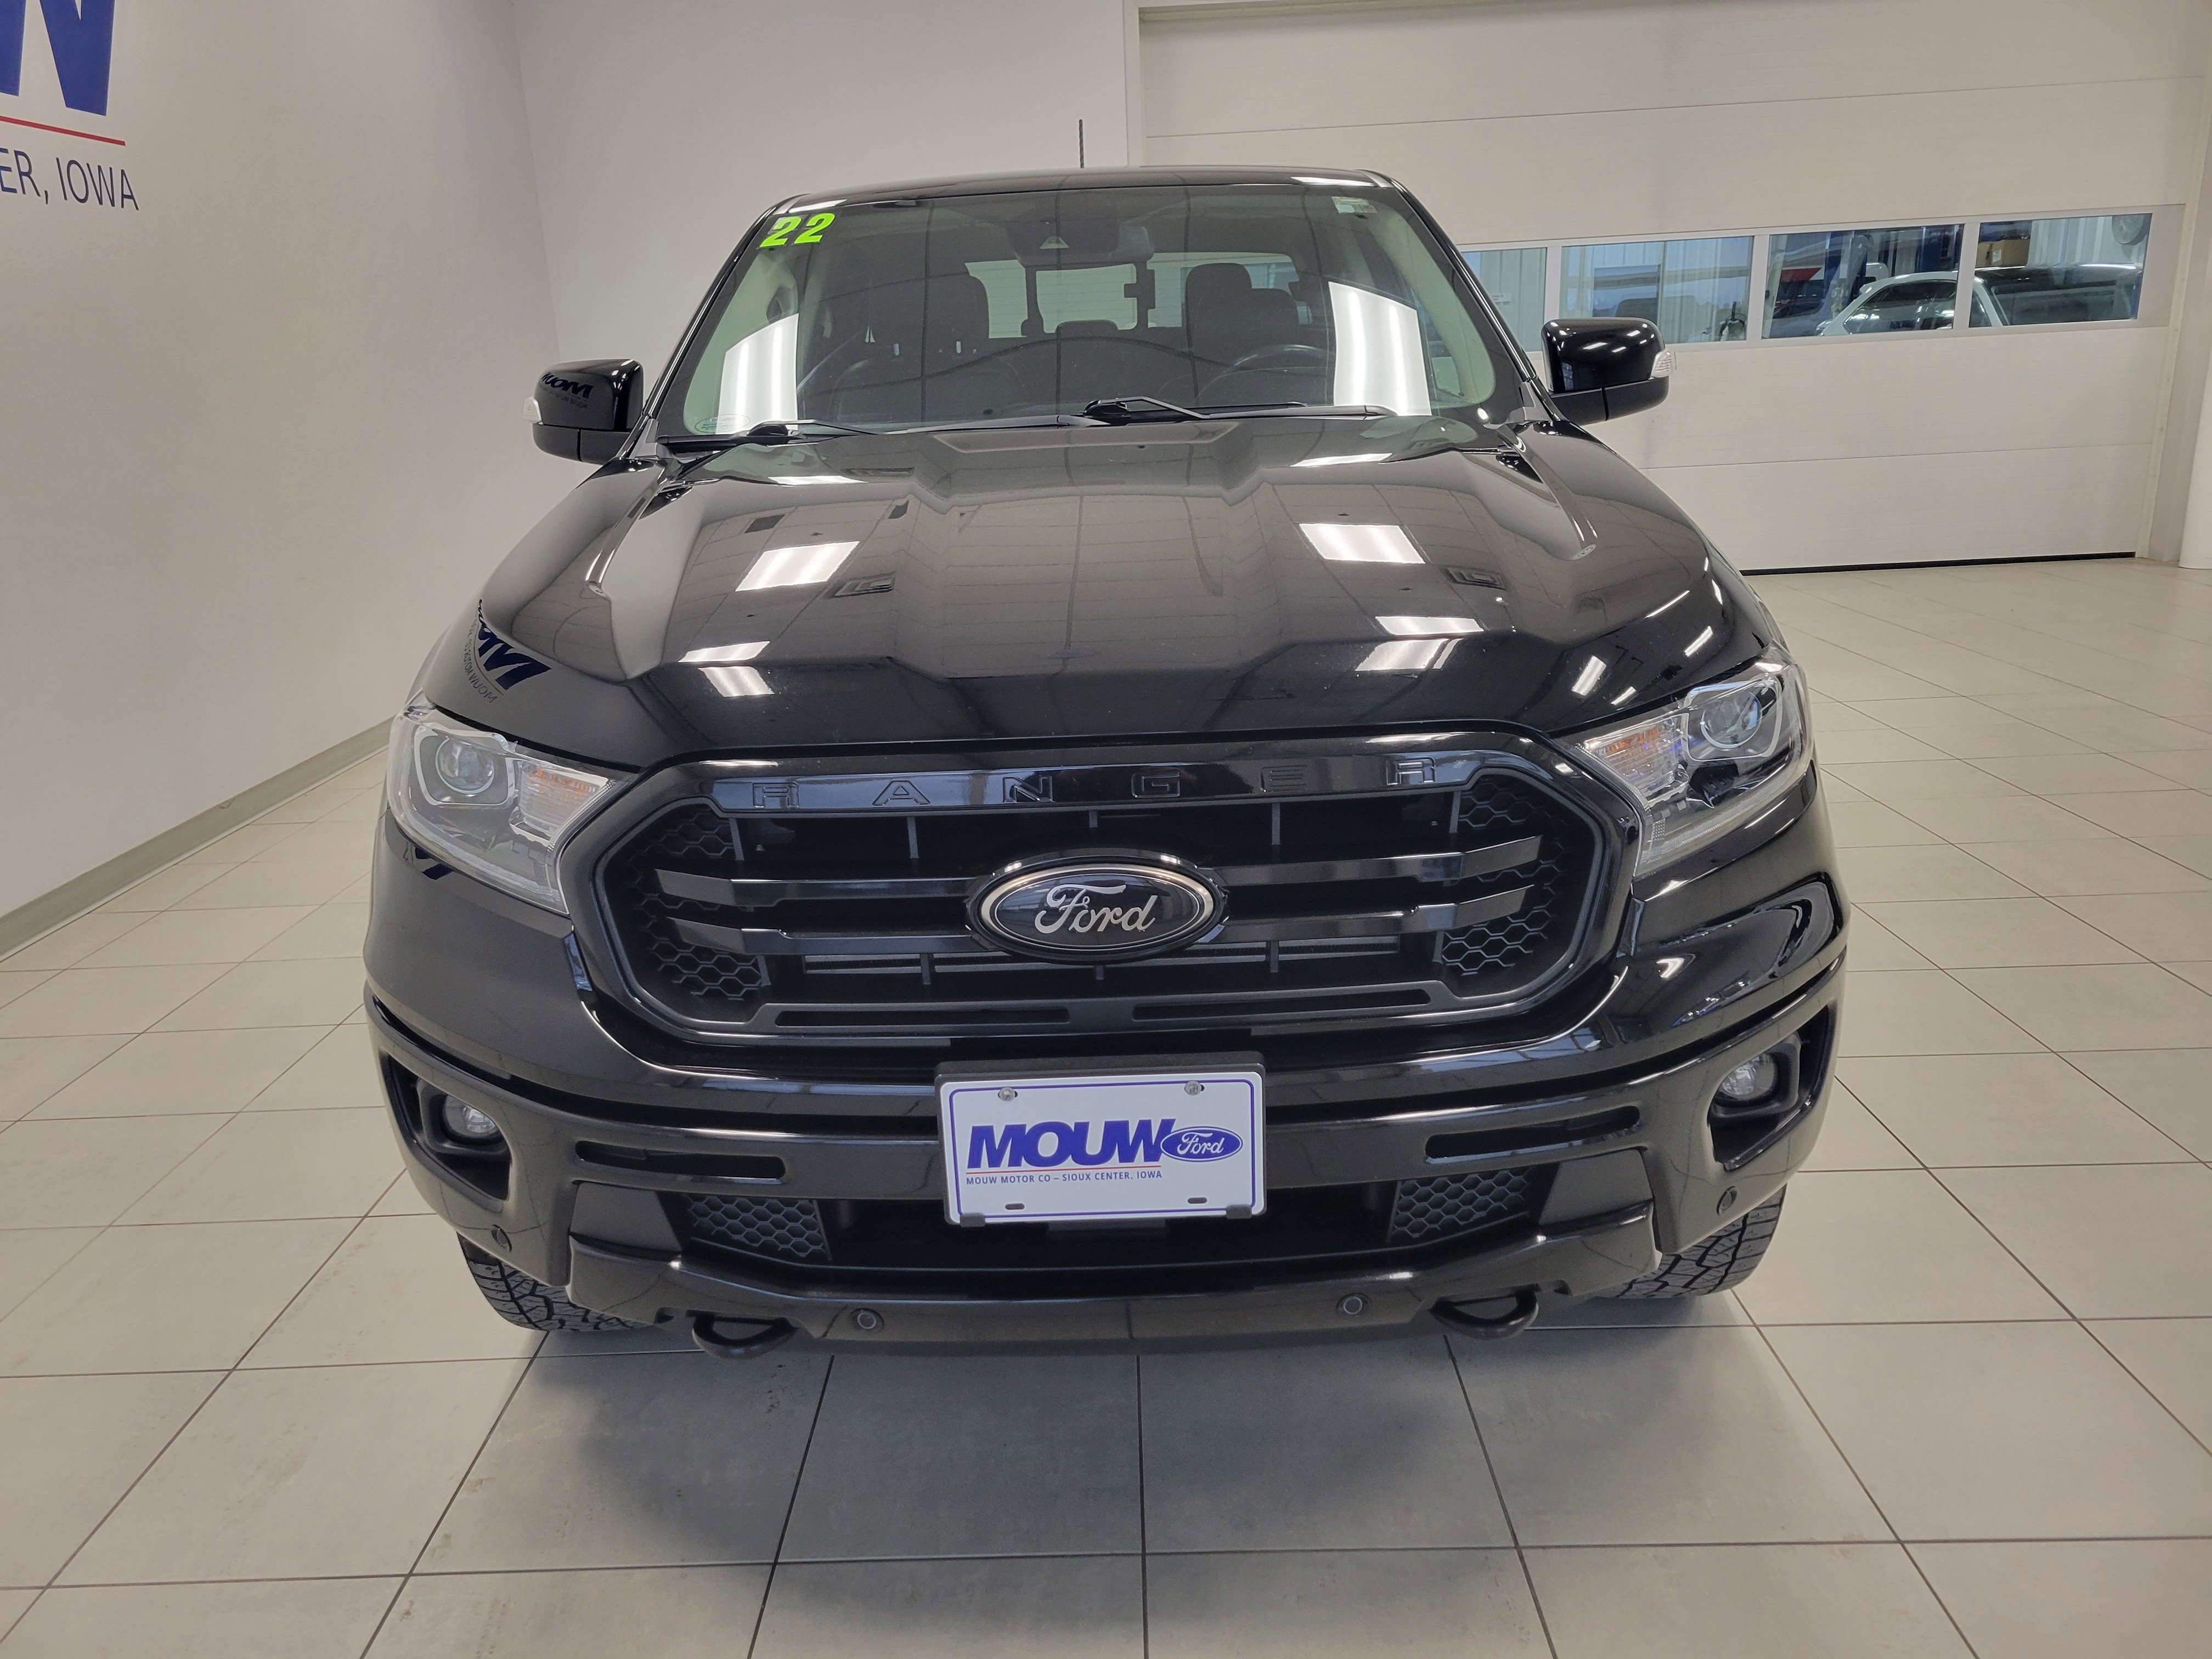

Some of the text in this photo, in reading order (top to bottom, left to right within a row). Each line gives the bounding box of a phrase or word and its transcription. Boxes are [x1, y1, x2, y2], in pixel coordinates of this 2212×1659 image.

[56, 157, 139, 211] IOWA
[759, 212, 836, 247] 22
[752, 757, 1436, 809] RANGER
[1035, 884, 1158, 934] Ford
[967, 1118, 1176, 1169] MOUW
[1177, 1132, 1225, 1155] Ford
[966, 1176, 997, 1185] MOUW
[1001, 1175, 1035, 1183] MOTOR
[1062, 1173, 1091, 1181] SIOUX
[1137, 1171, 1162, 1179] IOWA
